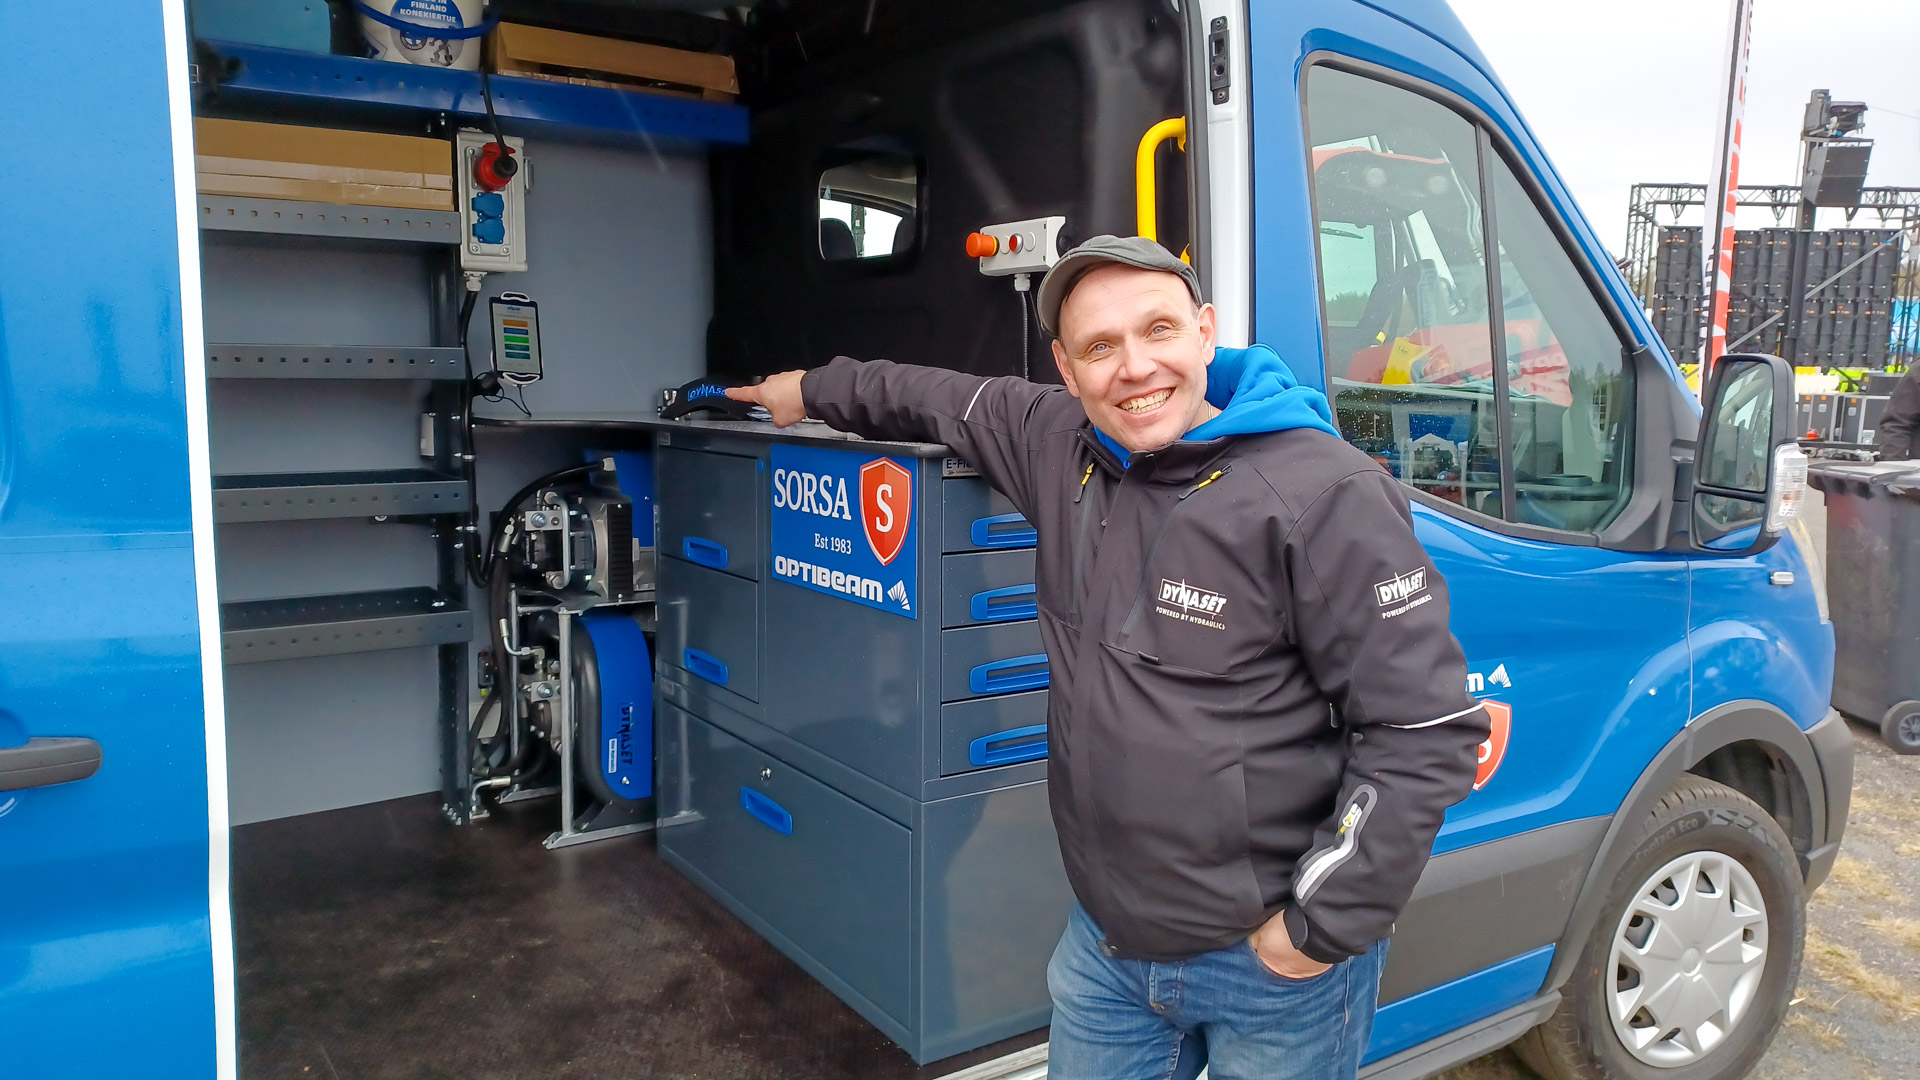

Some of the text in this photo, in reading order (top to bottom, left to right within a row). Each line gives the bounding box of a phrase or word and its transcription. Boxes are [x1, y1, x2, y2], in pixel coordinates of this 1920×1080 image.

[400, 8, 456, 23] KONEKIERTUE
[411, 1, 447, 13] FINLAND
[774, 468, 852, 521] SORSA
[875, 483, 894, 533] S
[814, 532, 852, 555] Est 1983
[1161, 578, 1227, 614] DYNASET
[1378, 570, 1425, 604] DYNASET
[1156, 605, 1226, 631] POWERED BY HYDRAULICS
[617, 706, 634, 766] DYNASET
